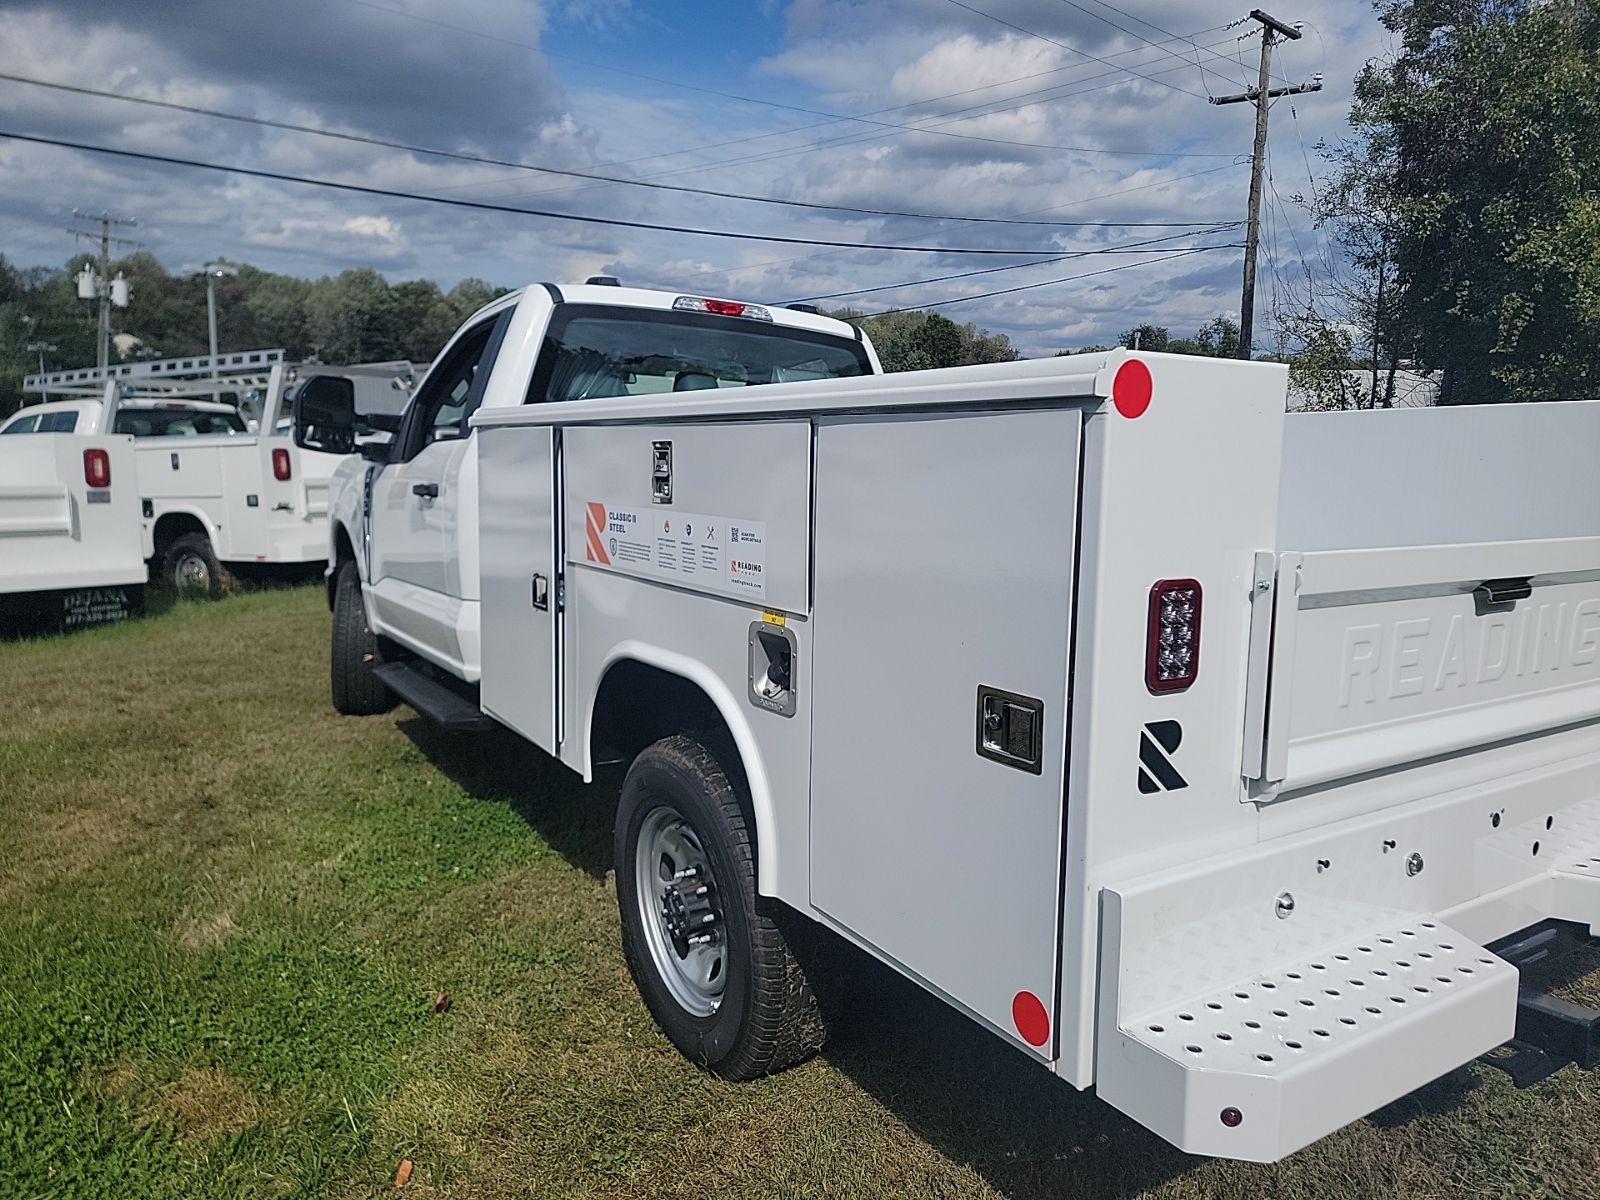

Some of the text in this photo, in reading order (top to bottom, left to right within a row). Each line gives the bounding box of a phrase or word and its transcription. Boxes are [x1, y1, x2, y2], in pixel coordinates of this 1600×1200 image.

[608, 511, 632, 523] CLASSIC
[609, 522, 626, 534] STEEL
[738, 562, 761, 572] READING
[1338, 600, 1600, 709] READING
